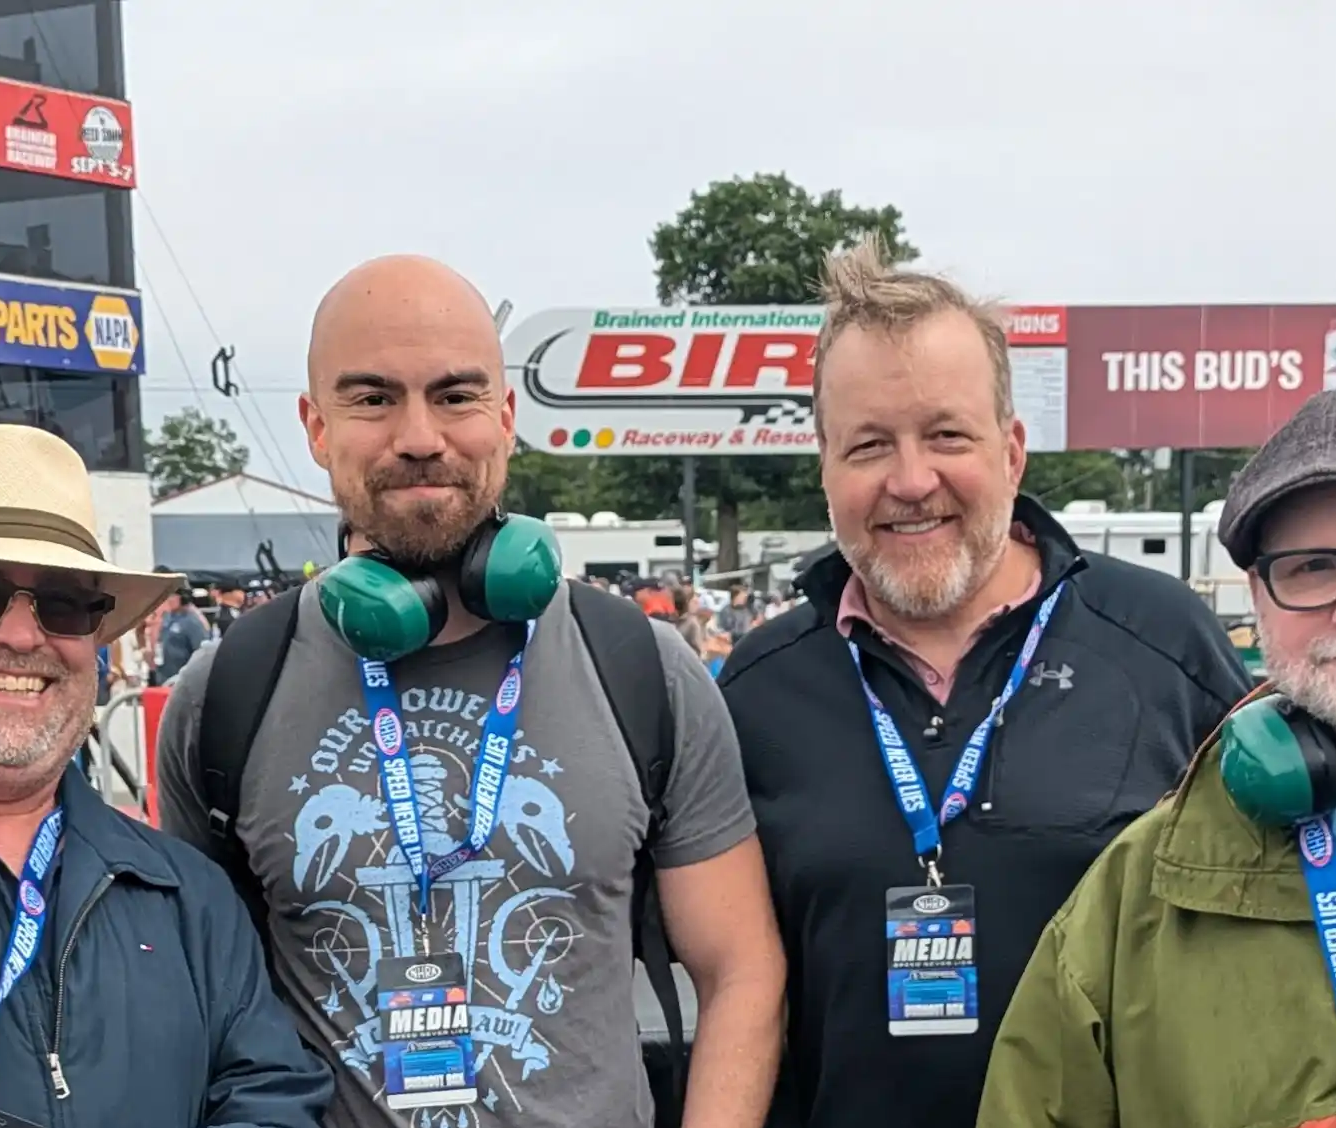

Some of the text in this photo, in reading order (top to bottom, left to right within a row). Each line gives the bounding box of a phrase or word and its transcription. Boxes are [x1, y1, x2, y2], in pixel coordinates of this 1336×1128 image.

[94, 316, 131, 350] NAPA
[594, 311, 684, 328] Brainerd
[1102, 352, 1184, 391] THIS
[1194, 350, 1304, 391] BUD'S
[621, 427, 724, 448] Raceway
[728, 427, 746, 446] &
[311, 708, 371, 774] OUR
[378, 713, 399, 750] NHRA
[875, 709, 926, 813] SPEED NEVER LIES
[952, 746, 983, 791] SPEED
[470, 733, 510, 851] SPEED NEVER LIES
[384, 757, 423, 876] SPEED NEVER LIES
[12, 911, 40, 959] SPEED
[893, 936, 973, 962] MEDIA
[410, 965, 438, 980] NHRA
[389, 1004, 469, 1035] MEDIA
[475, 1014, 521, 1037] AW!
